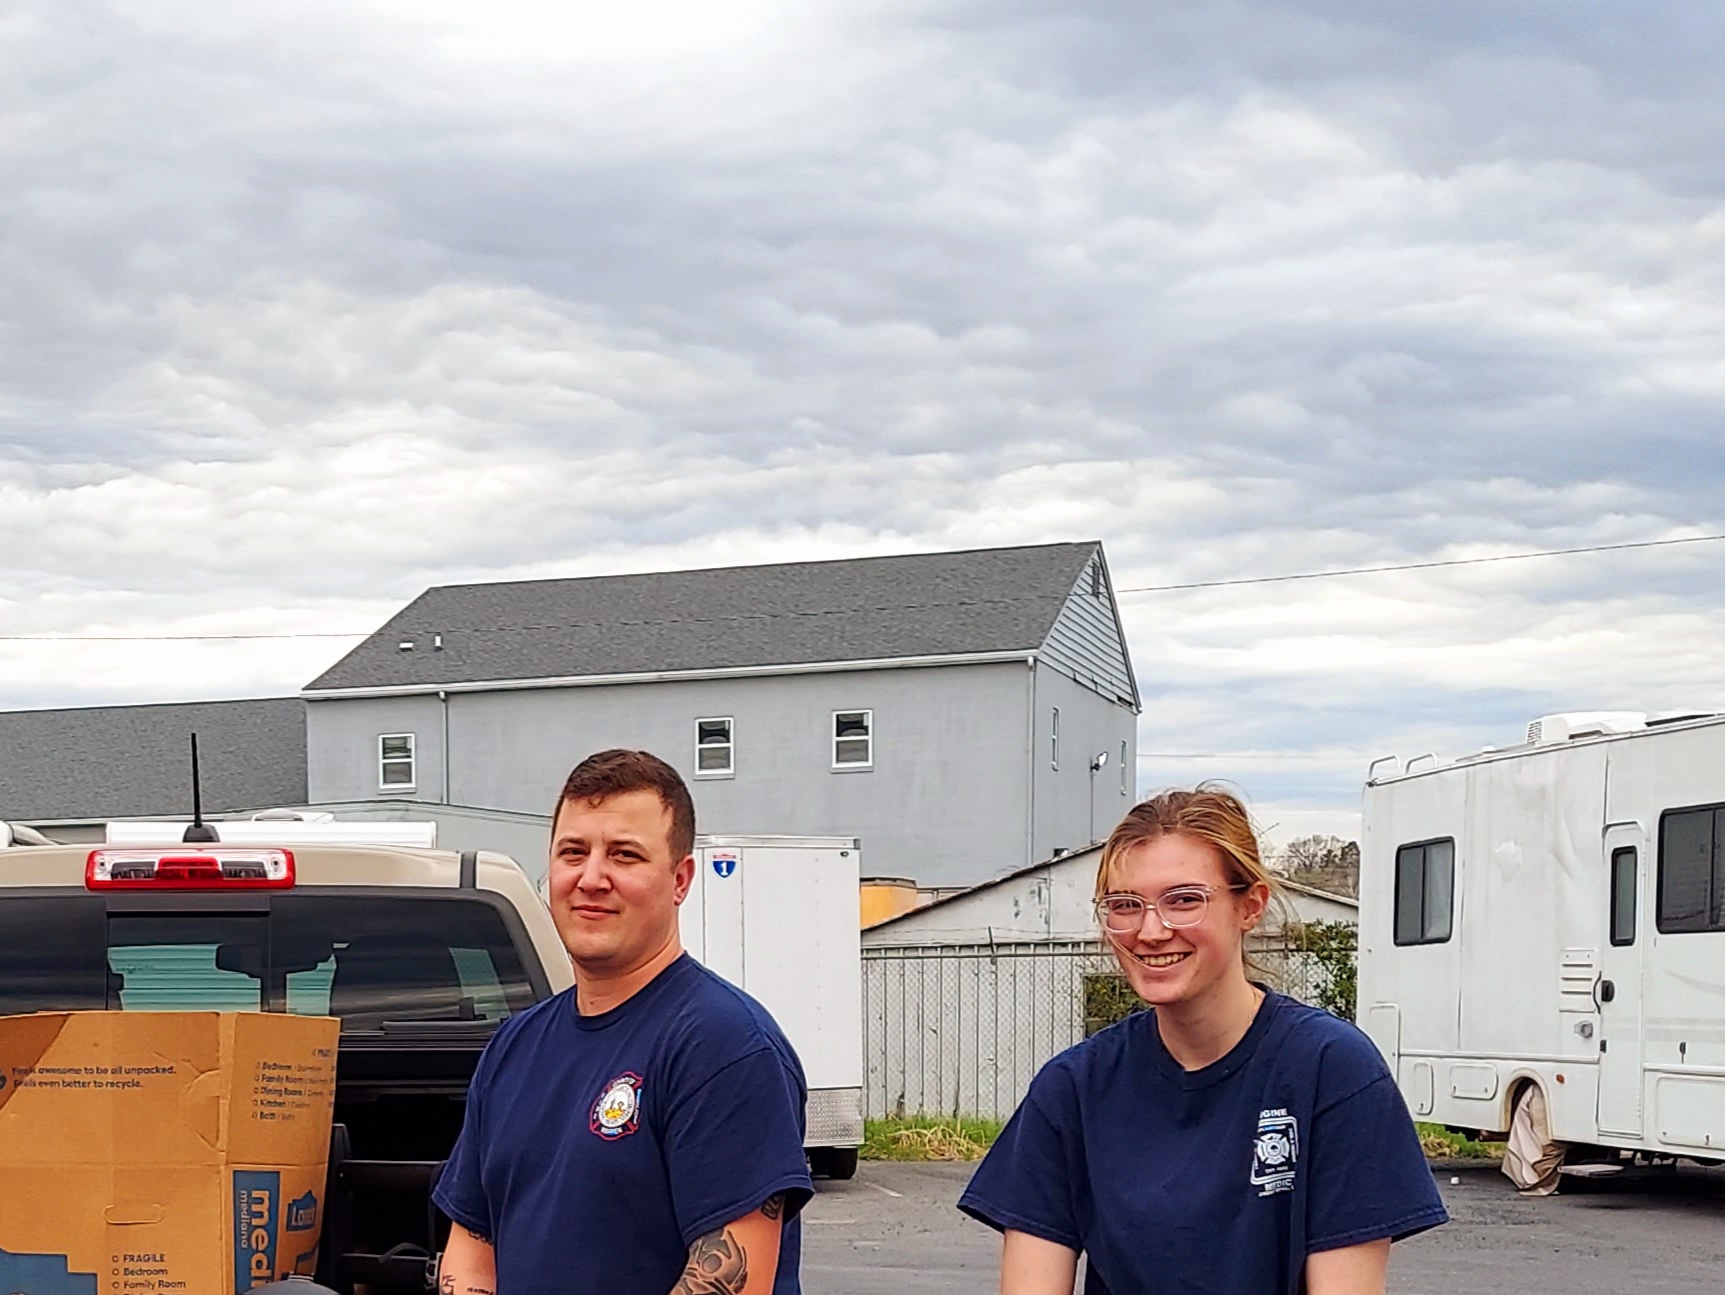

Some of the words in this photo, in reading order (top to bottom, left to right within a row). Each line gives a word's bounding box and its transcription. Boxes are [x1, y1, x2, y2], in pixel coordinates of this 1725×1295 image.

[38, 1067, 82, 1075] awesome
[96, 1066, 108, 1074] be
[124, 1066, 177, 1077] unpacked.
[38, 1080, 60, 1088] even
[62, 1079, 91, 1088] better
[93, 1080, 104, 1088] to
[105, 1079, 143, 1090] recycle.
[123, 1254, 166, 1262] FRAGILE
[123, 1268, 169, 1276] Bedroom
[123, 1280, 156, 1290] Family
[158, 1280, 186, 1288] Room
